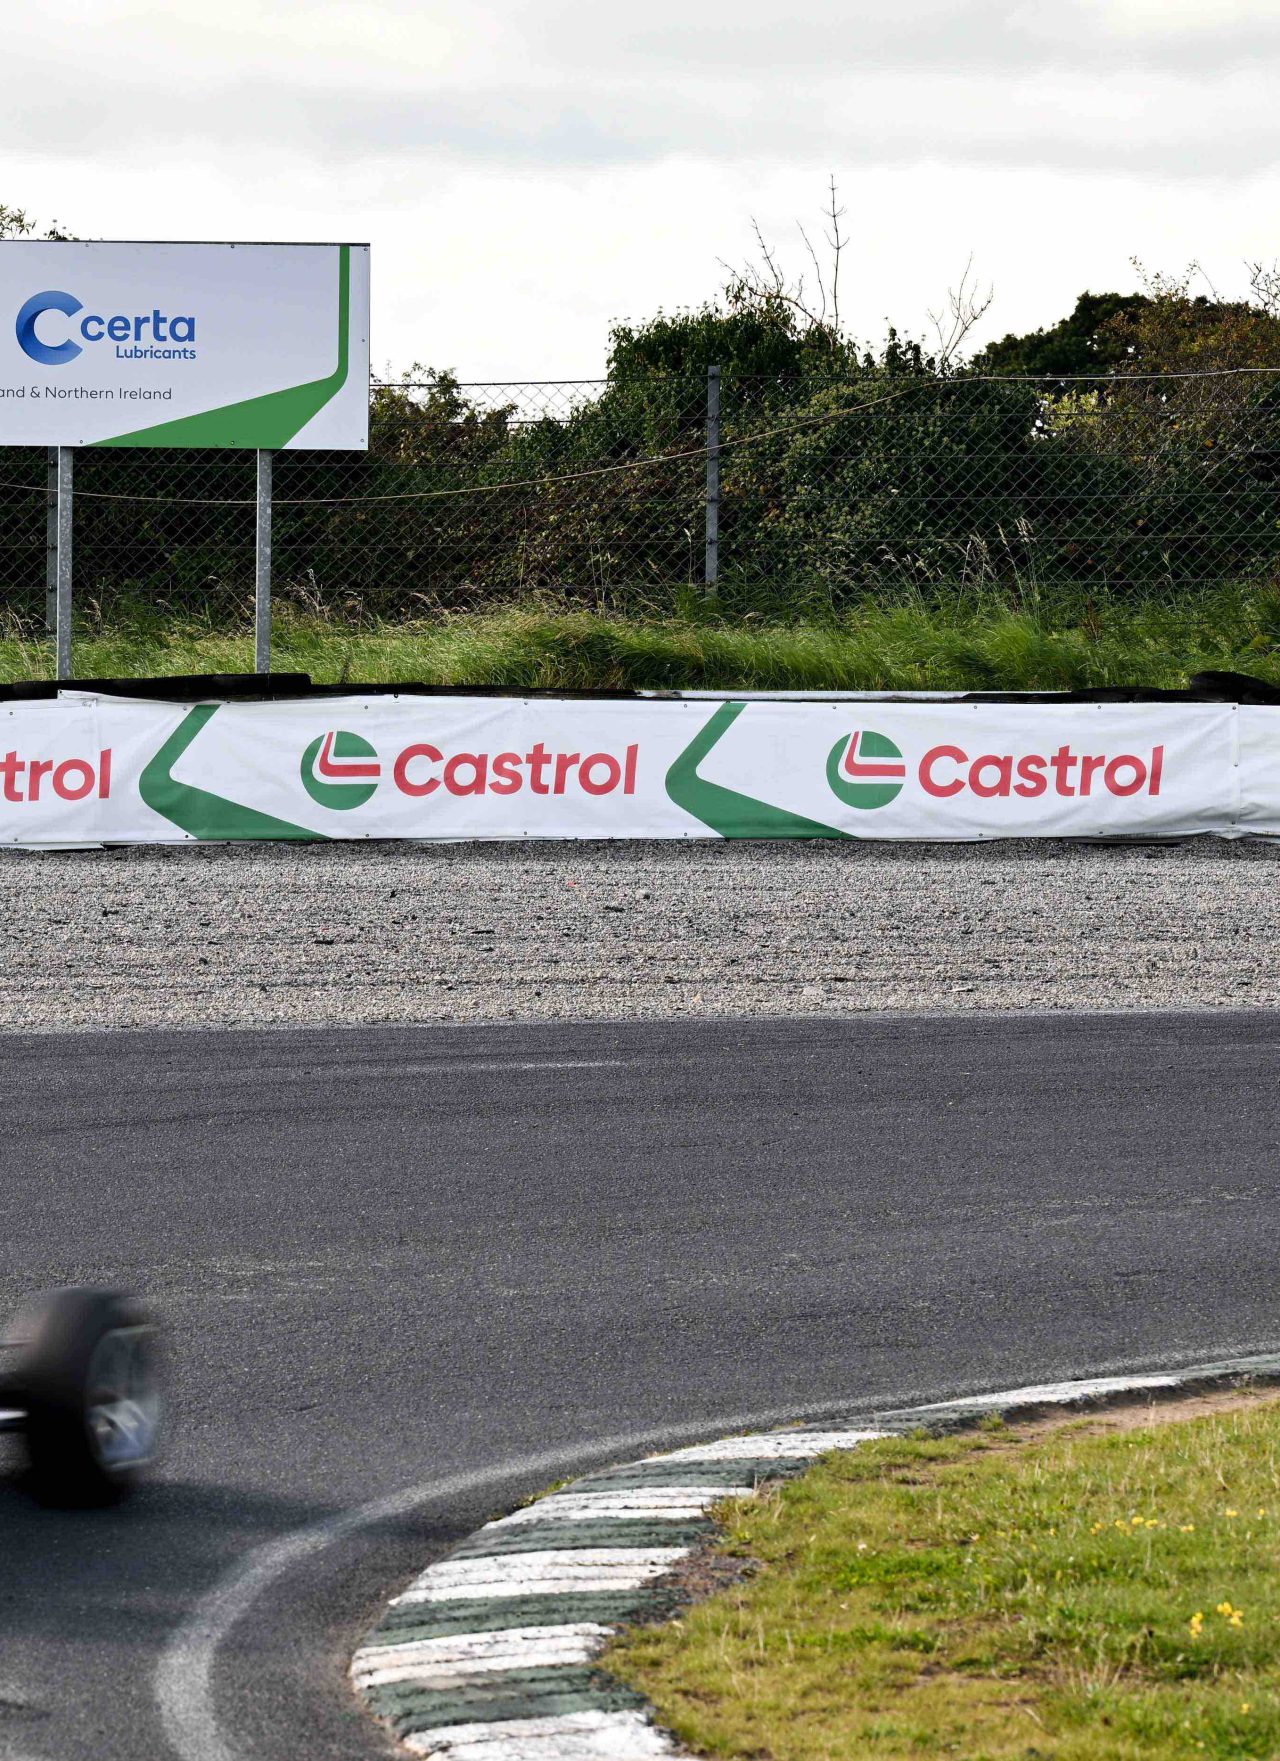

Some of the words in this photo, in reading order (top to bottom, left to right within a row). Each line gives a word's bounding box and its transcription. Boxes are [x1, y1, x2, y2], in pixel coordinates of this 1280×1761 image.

[115, 345, 197, 360] Lubricants
[29, 386, 41, 398] &
[44, 386, 114, 399] Northern
[119, 387, 172, 400] Ireland
[393, 743, 638, 797] Castrol
[918, 745, 1164, 797] Castrol
